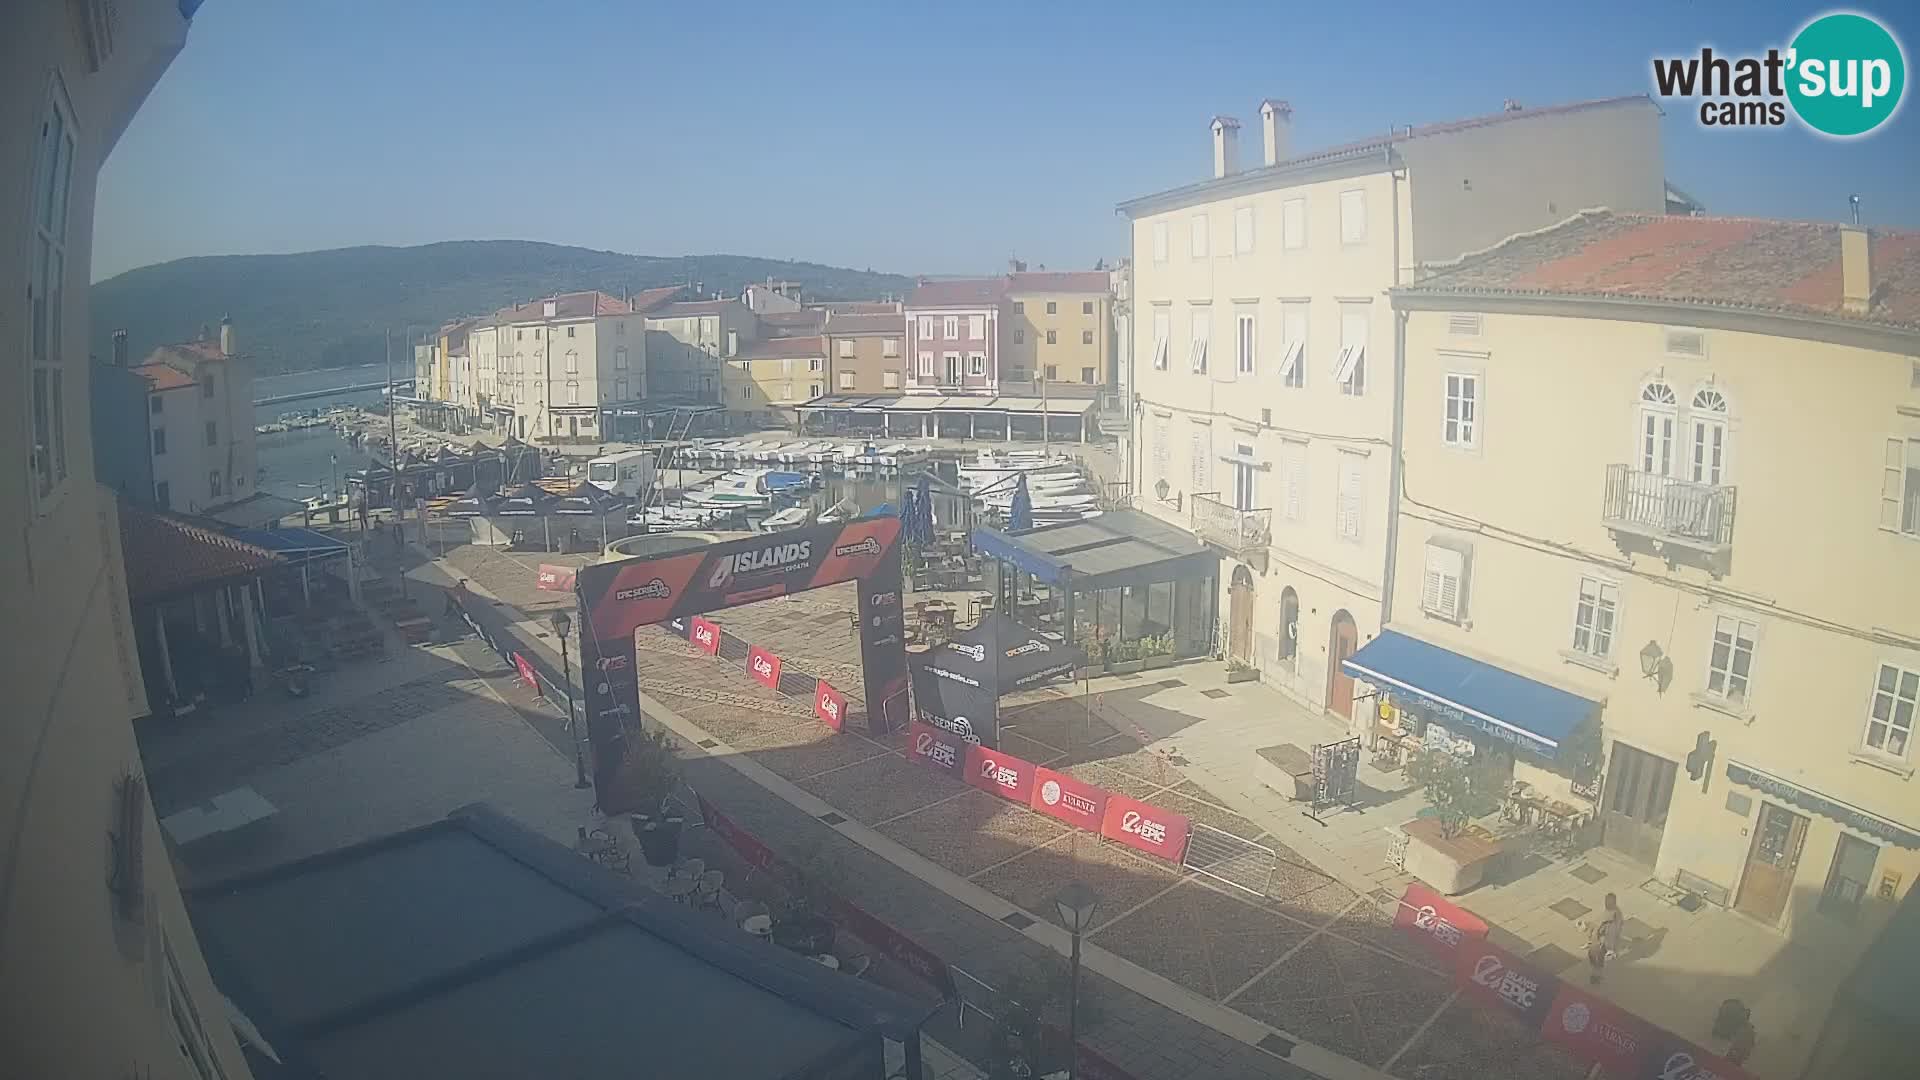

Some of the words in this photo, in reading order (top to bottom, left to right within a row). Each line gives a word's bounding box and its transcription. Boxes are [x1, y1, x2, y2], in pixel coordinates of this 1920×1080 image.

[734, 541, 811, 573] ISLANDS
[935, 716, 966, 737] SERIES
[933, 748, 955, 766] EPIC
[997, 772, 1018, 788] EPIC
[1141, 826, 1167, 844] EPIC
[1499, 979, 1537, 1007] EPIC
